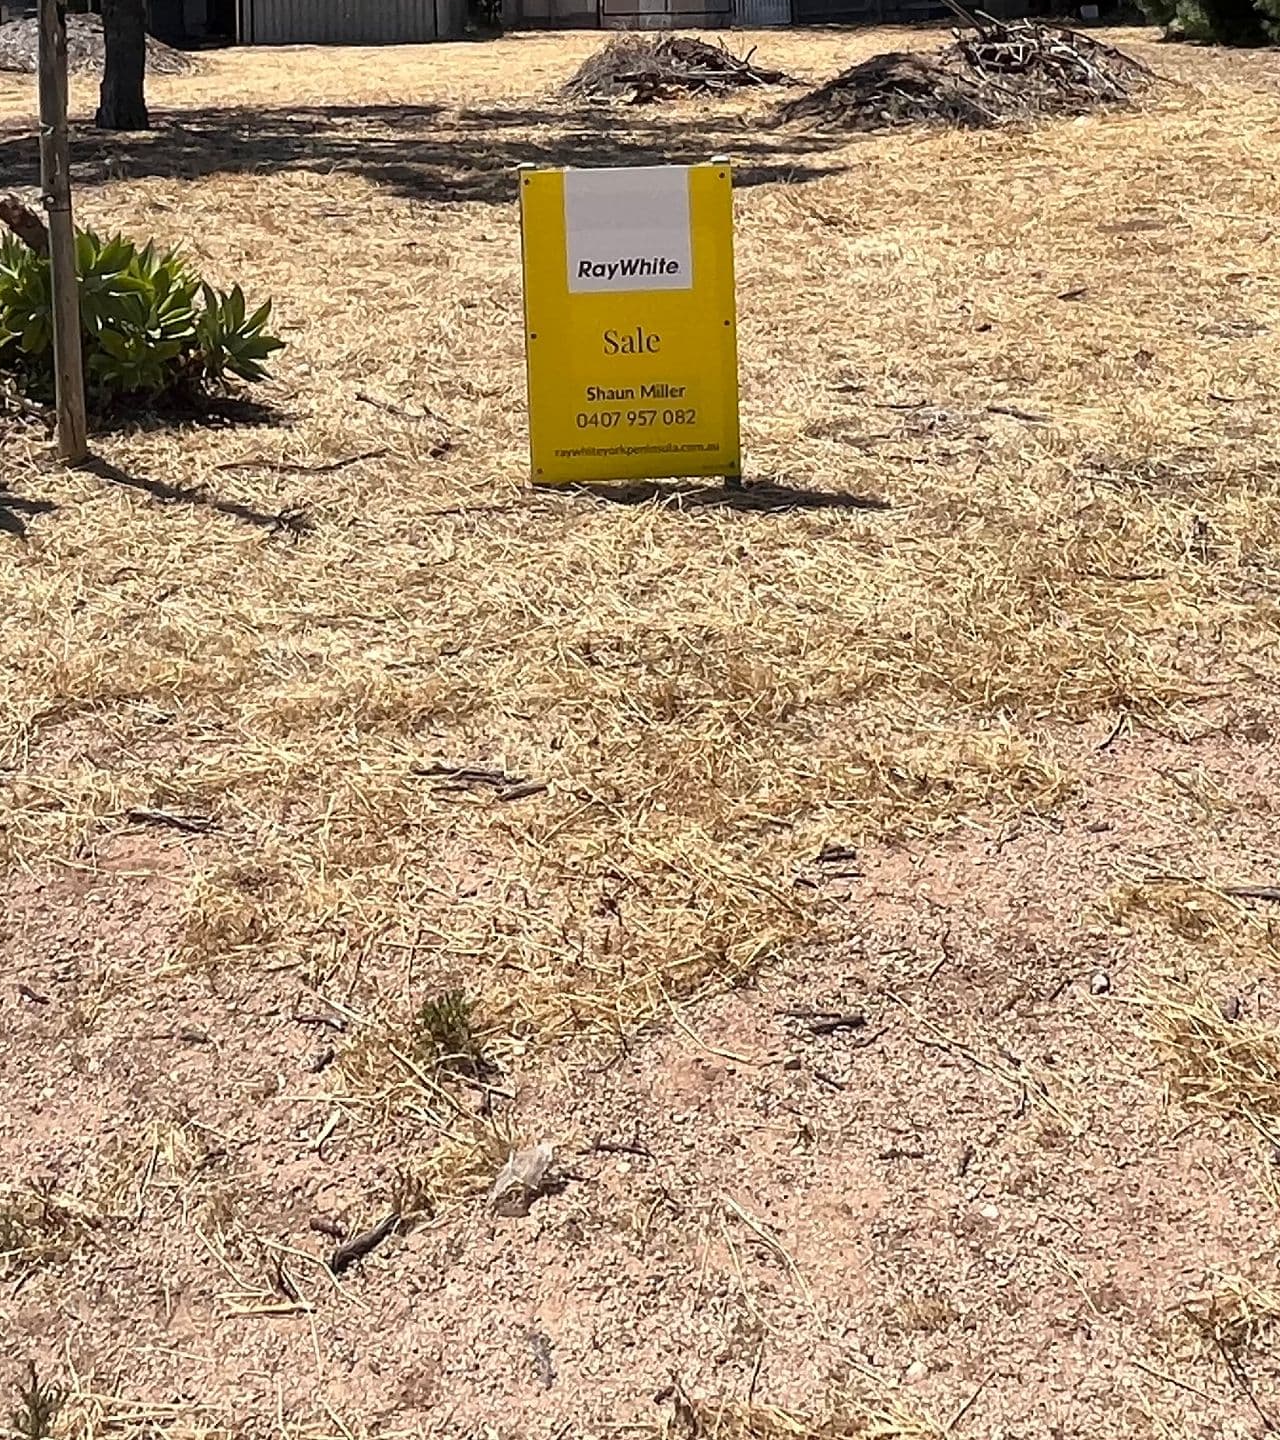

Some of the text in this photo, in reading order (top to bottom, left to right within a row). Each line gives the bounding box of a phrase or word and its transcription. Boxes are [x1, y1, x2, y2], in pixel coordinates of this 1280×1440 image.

[577, 257, 679, 279] RayWhite
[603, 327, 661, 355] Sale
[586, 385, 686, 401] Shaun Miller
[576, 409, 696, 428] 0407 957 082
